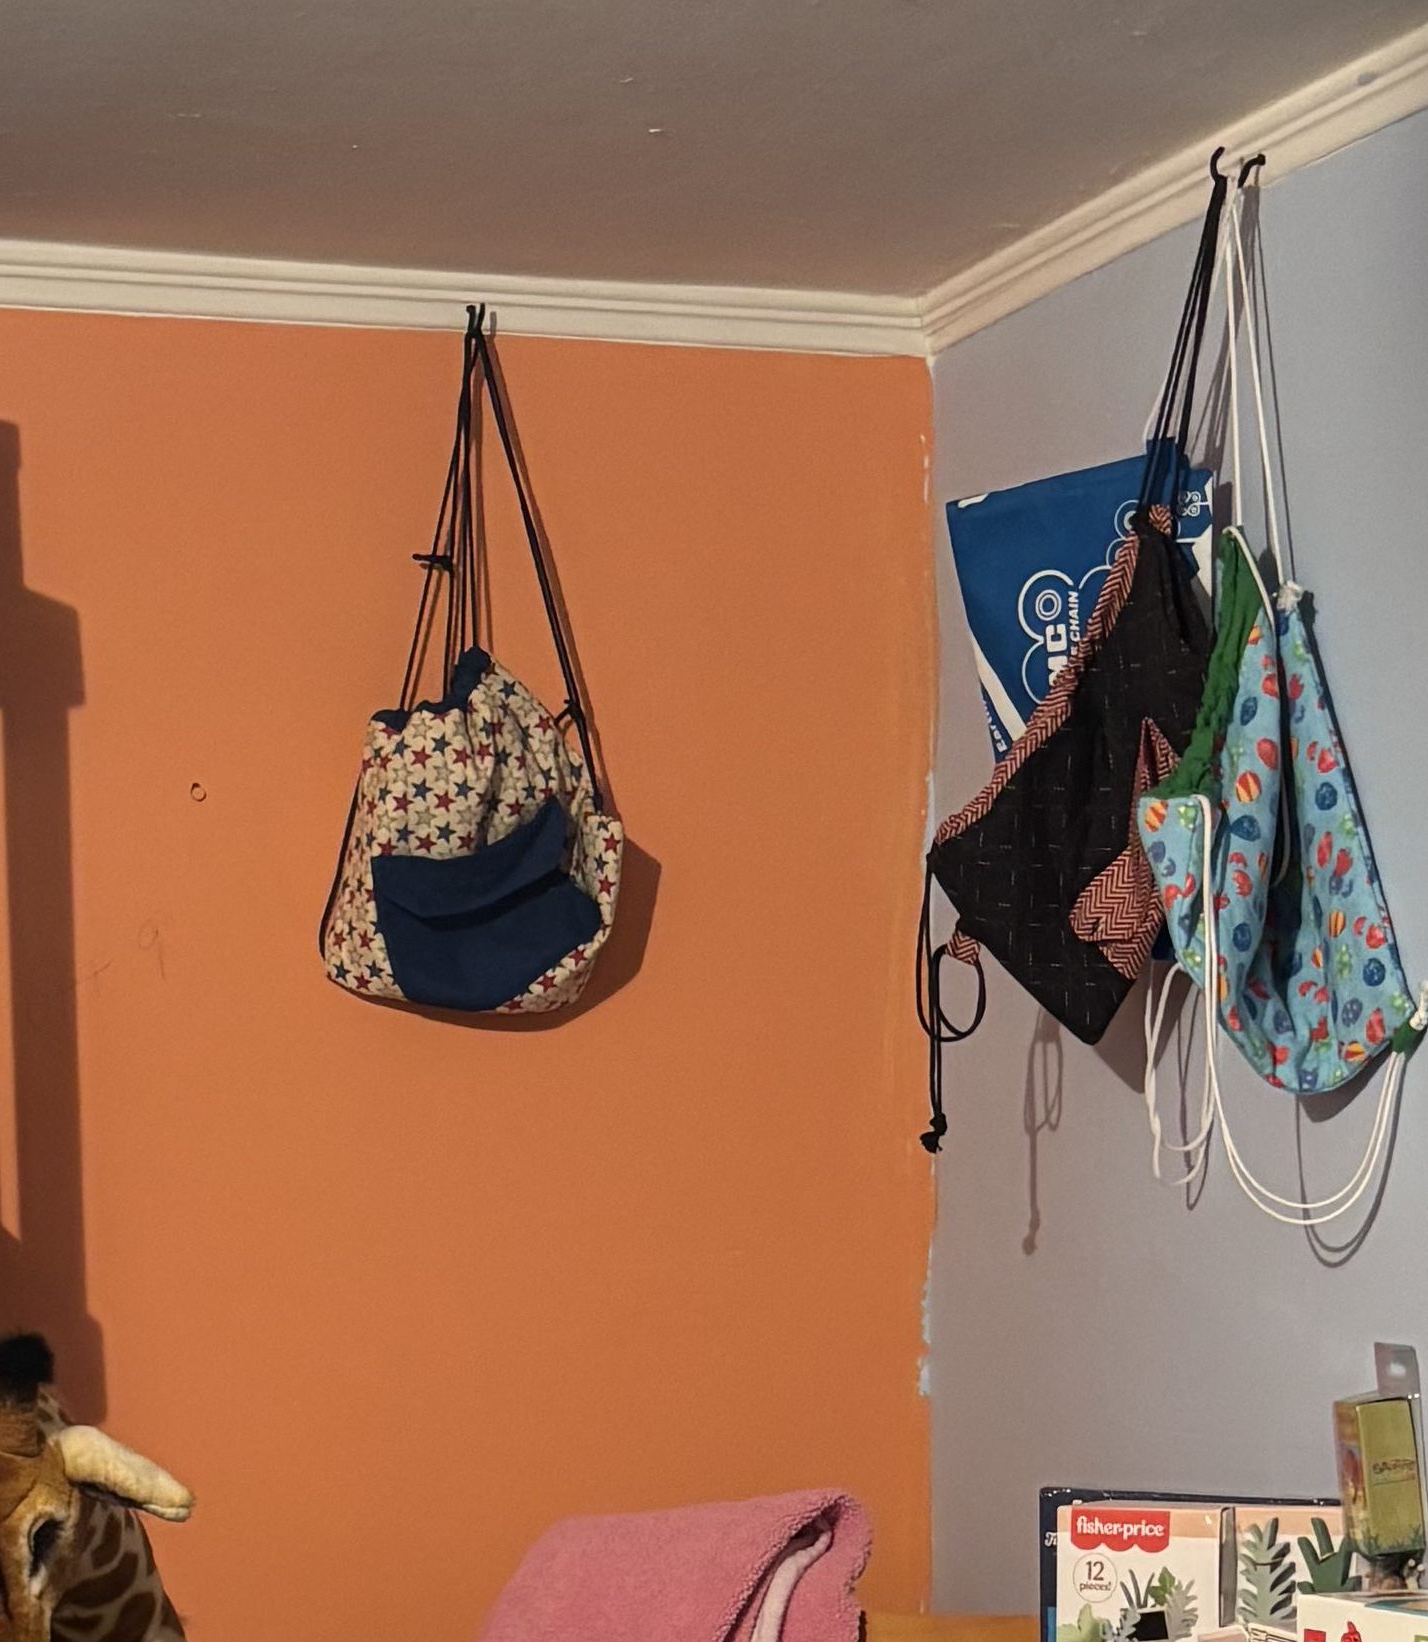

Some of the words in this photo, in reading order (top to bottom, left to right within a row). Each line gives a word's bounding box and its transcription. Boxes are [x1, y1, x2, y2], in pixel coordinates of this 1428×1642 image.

[1068, 591, 1080, 642] CHAIN
[1075, 1514, 1165, 1541] fisher-price
[1085, 1560, 1106, 1582] 12
